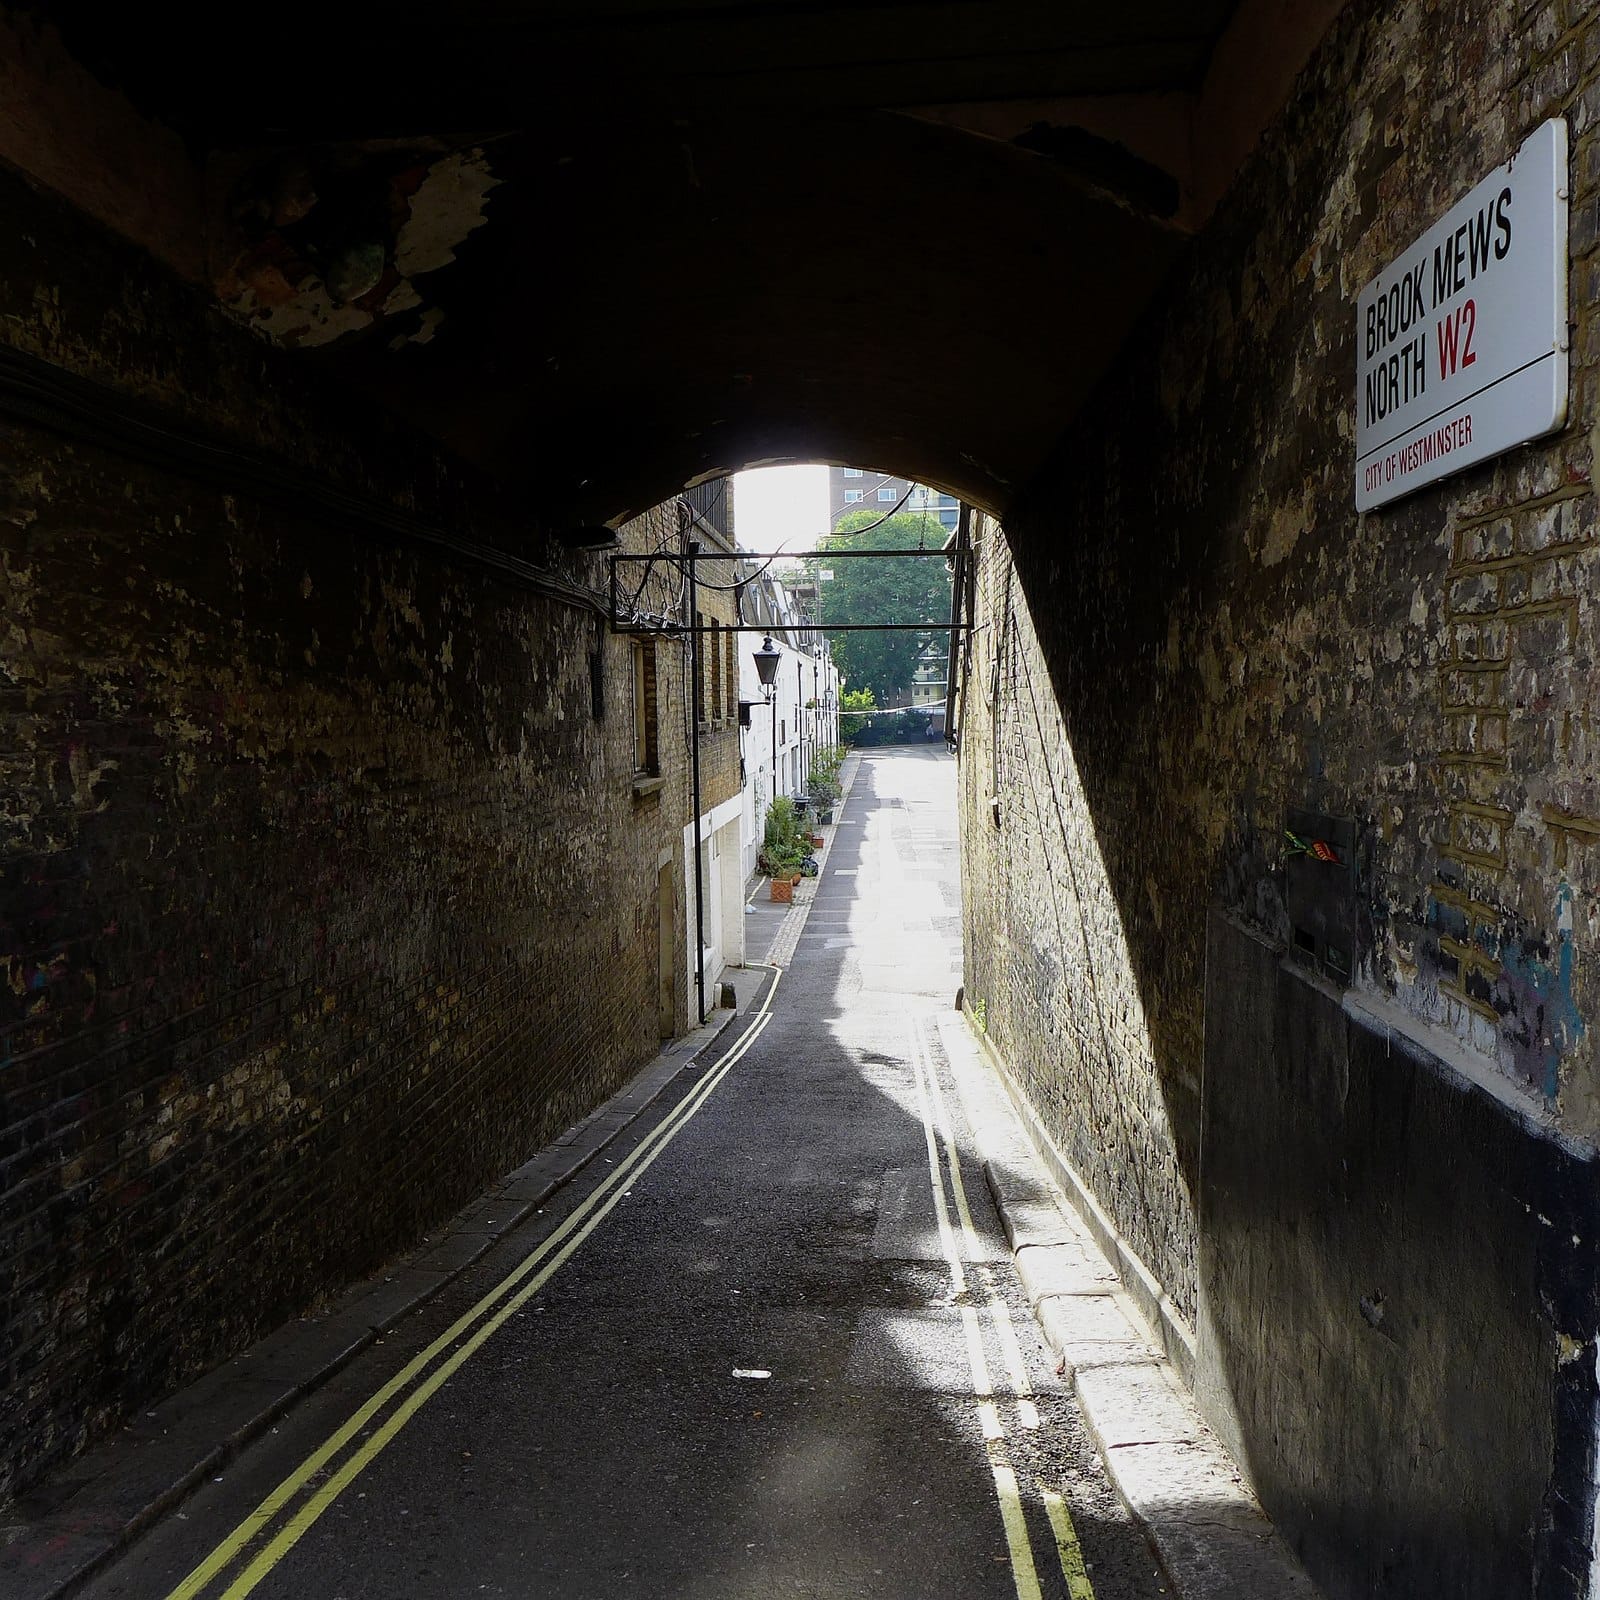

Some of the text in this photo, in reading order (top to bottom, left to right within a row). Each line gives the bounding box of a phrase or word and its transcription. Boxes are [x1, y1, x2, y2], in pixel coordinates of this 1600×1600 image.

[1366, 187, 1512, 361] BROOK MEWS
[1366, 299, 1476, 429] NORTH W2
[1365, 414, 1473, 492] CITY OF WESTMINSTER
